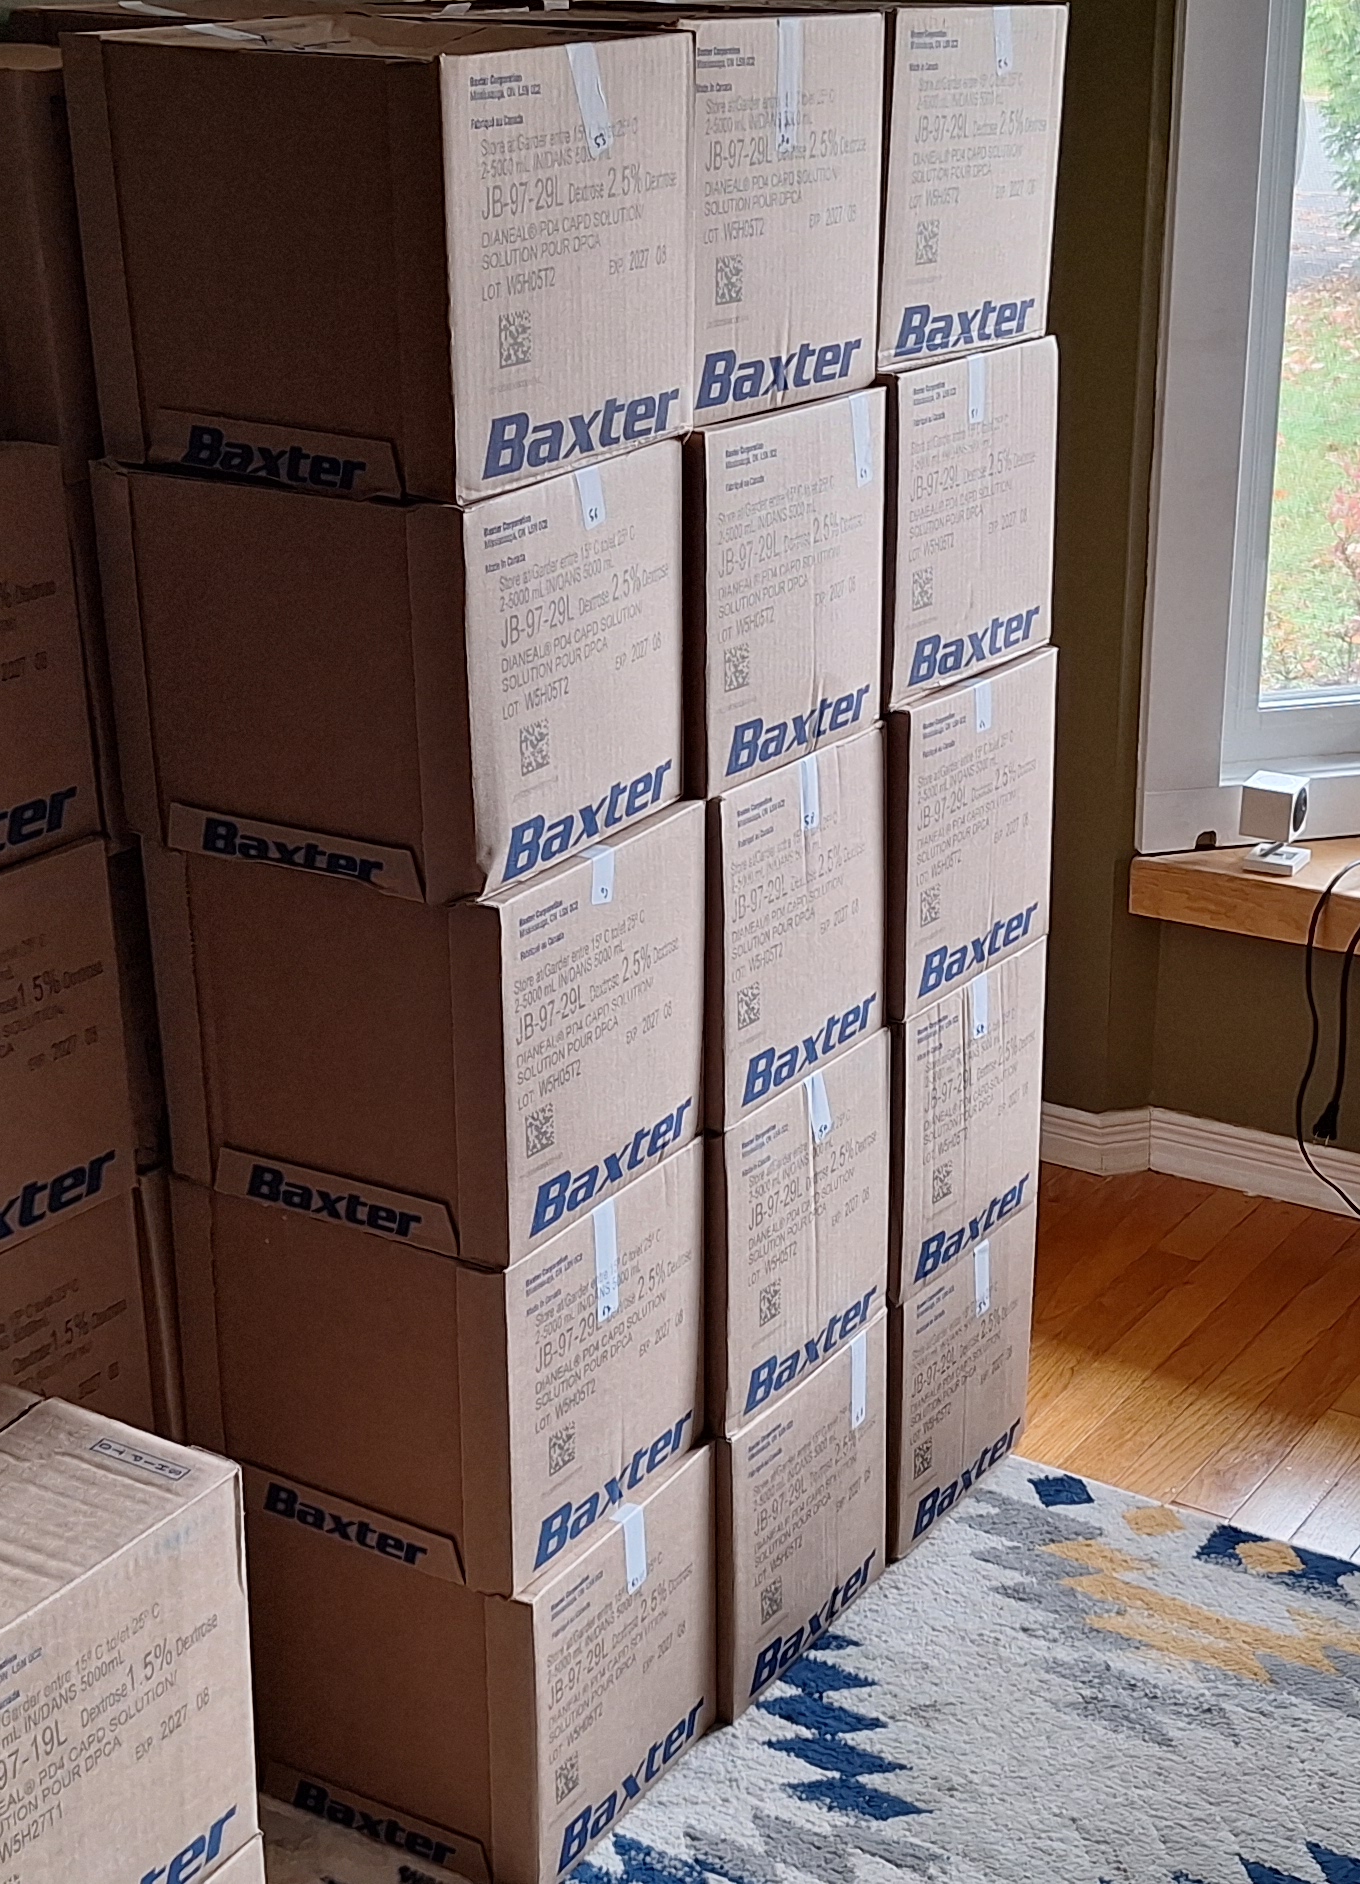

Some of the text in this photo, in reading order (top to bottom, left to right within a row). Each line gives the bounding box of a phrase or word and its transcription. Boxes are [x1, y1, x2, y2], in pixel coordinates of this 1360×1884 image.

[705, 134, 773, 172] JB-97-29L
[482, 163, 642, 220] JB-97-29L 2.5%
[482, 240, 570, 271] SOLUTION POUR
[894, 298, 1035, 358] Baxter
[695, 337, 862, 410] Baxter
[182, 424, 366, 490] Baxter
[482, 388, 680, 480] Baxter
[718, 530, 781, 579] JB-97-29L
[501, 563, 641, 649] JB-97-29L 2.5%
[718, 590, 762, 619] SOLUTION
[502, 637, 609, 693] SOLUTION POUR DPCA
[907, 605, 1041, 687] Baxter
[725, 684, 870, 777] Baxter
[202, 816, 384, 882] Baxter
[501, 759, 672, 884] Baxter
[572, 944, 589, 963] entre
[917, 901, 1039, 998] Baxter
[514, 987, 542, 1013] 2-5000
[544, 981, 556, 996] mL
[516, 984, 586, 1046] JB-97-29L
[622, 944, 652, 984] 2.5%
[642, 1009, 659, 1035] 2027
[517, 1016, 619, 1085] SOLUTION POUR DPCA
[538, 1059, 581, 1098] W5H05T2
[741, 991, 877, 1107] Baxter
[246, 1163, 422, 1237] Baxter
[529, 1097, 692, 1239] Baxter
[913, 1172, 1030, 1283] Baxter
[536, 1260, 666, 1373] JB-97-29L 2.5%
[601, 1322, 625, 1351] CAPD
[743, 1285, 877, 1416] Baxter
[535, 1367, 582, 1411] SOLUTION
[584, 1348, 608, 1376] POUR
[131, 1453, 182, 1476] SHIP
[533, 1409, 693, 1571] Baxter
[912, 1417, 1021, 1541] Baxter
[262, 1481, 428, 1565] Baxter
[44, 1671, 71, 1697] entre
[152, 1603, 160, 1621] C
[749, 1548, 876, 1697] Baxter
[80, 1683, 127, 1728] Dextrose
[126, 1638, 172, 1691] 1.5%
[175, 1614, 218, 1658] Dextrose
[549, 1640, 609, 1710] JB-97-29L
[2, 1726, 21, 1750] mL
[24, 1684, 77, 1732] IN/DANS
[160, 1703, 188, 1741] 2027
[39, 1758, 66, 1787] PD4
[69, 1726, 106, 1768] CAPD
[42, 1767, 81, 1803] POUR
[84, 1735, 122, 1773] DPCA
[557, 1696, 704, 1875] Baxter
[293, 1778, 457, 1864] Baxter
